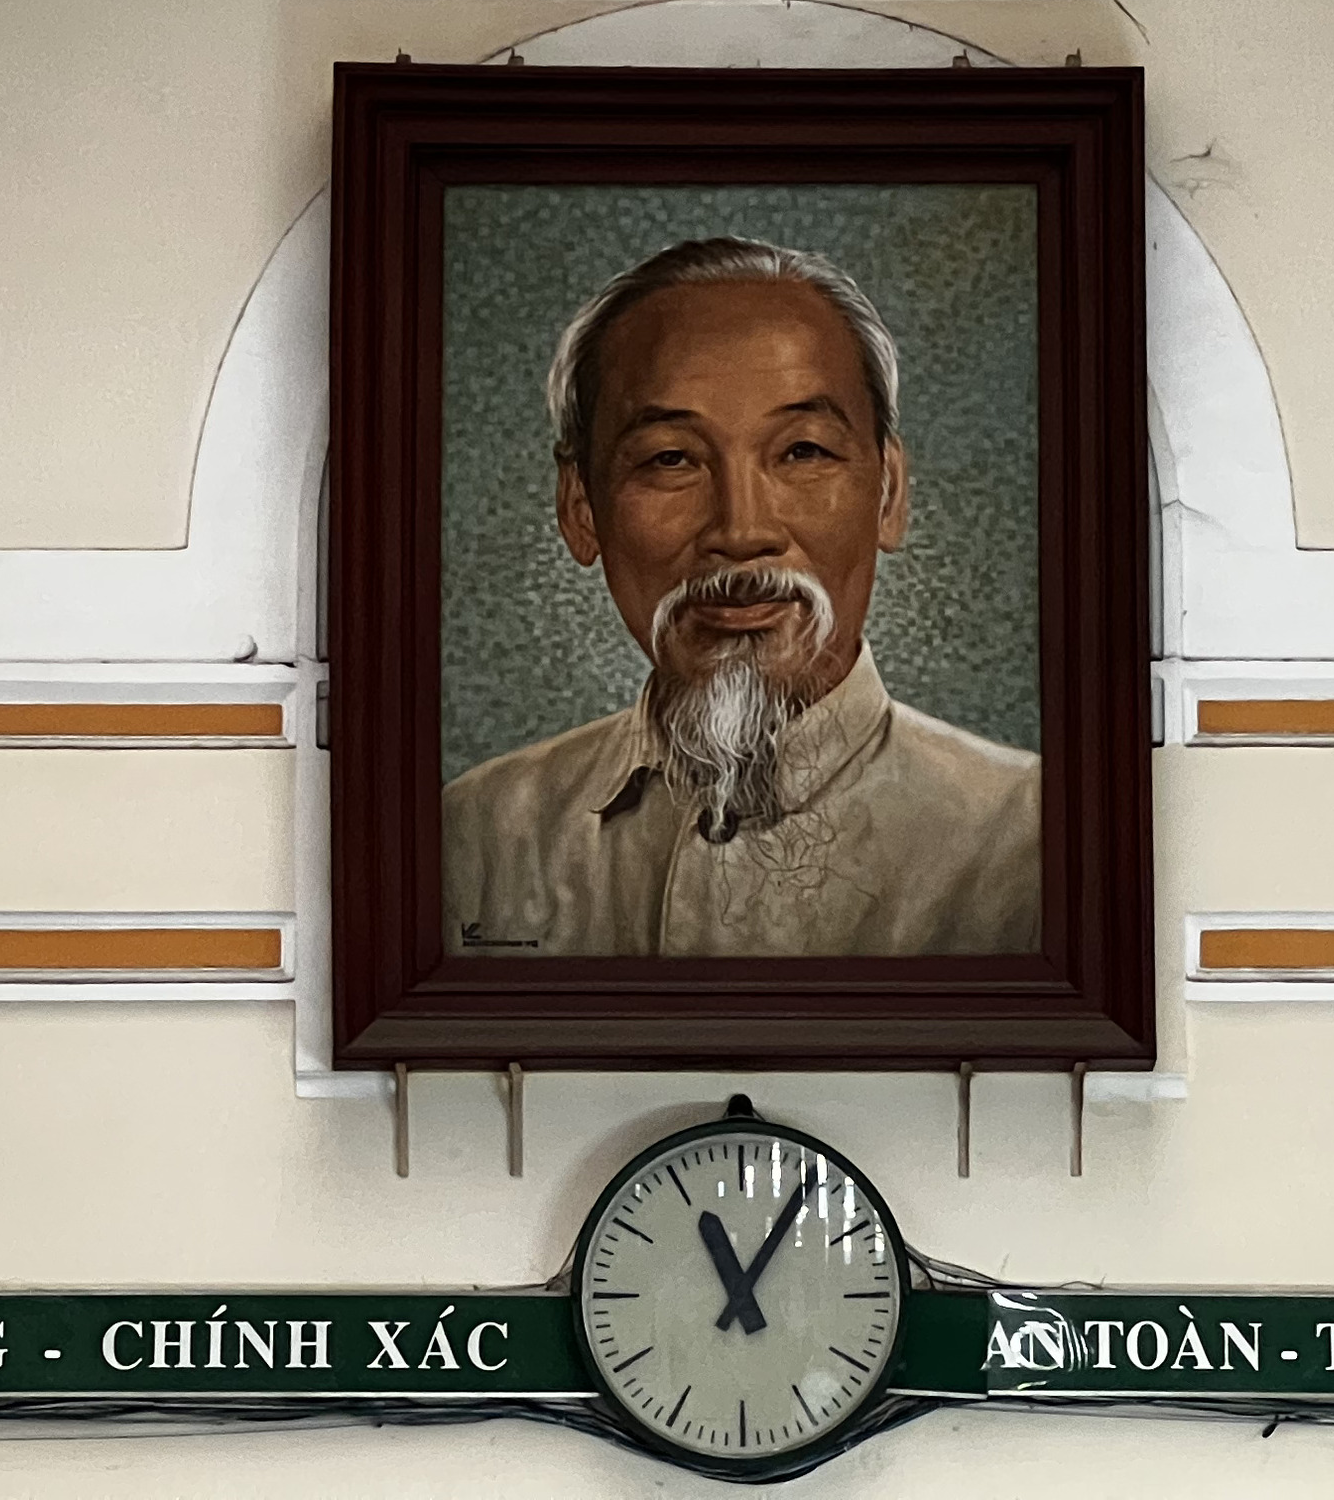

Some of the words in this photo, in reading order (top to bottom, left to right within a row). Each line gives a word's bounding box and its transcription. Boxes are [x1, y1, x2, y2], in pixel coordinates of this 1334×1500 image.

[102, 1305, 333, 1371] CHÍNH
[367, 1305, 508, 1371] XÁC
[981, 1320, 1068, 1370] AN
[1084, 1305, 1263, 1372] TOÀN
